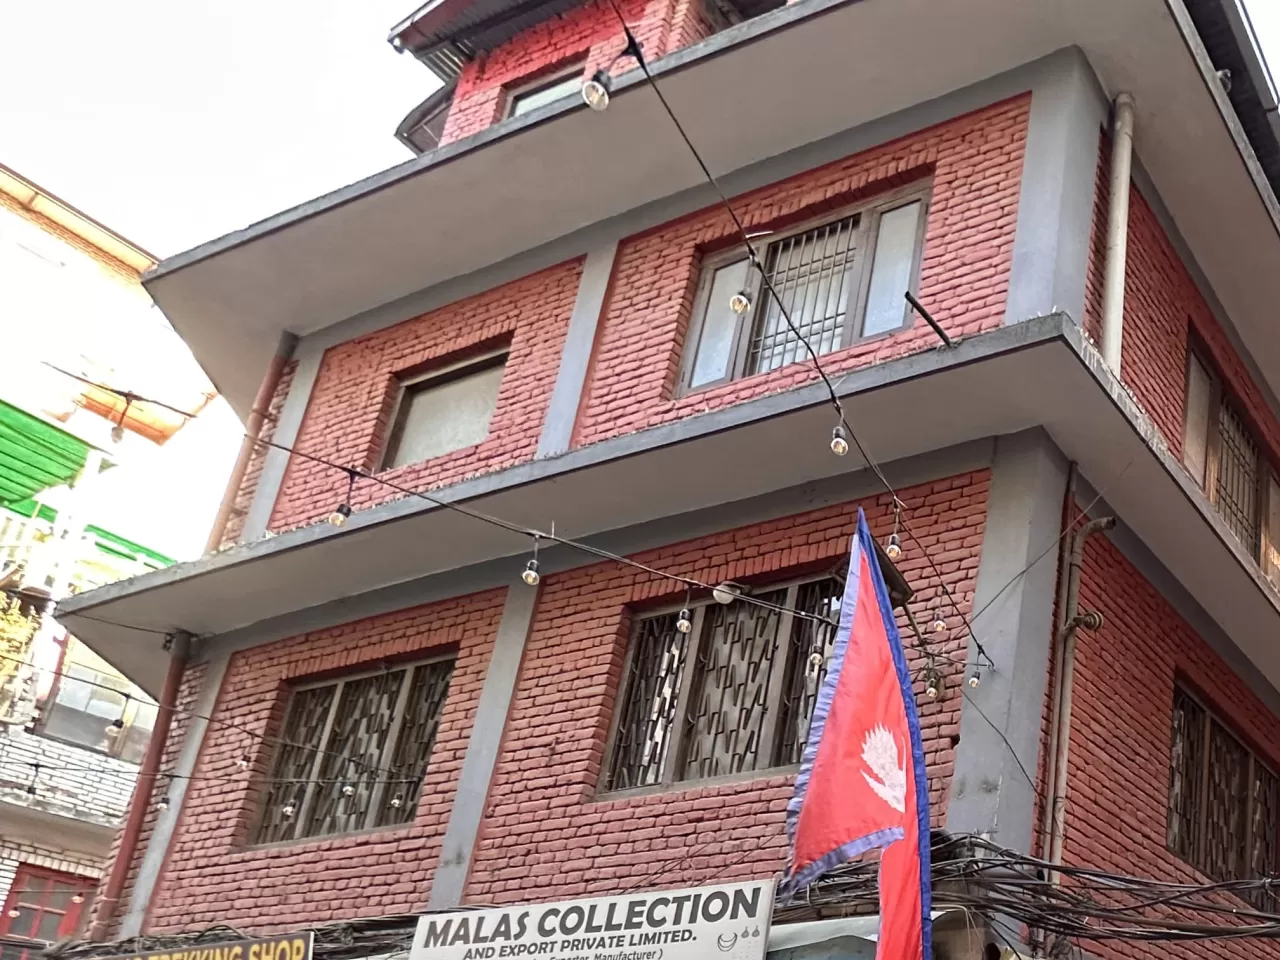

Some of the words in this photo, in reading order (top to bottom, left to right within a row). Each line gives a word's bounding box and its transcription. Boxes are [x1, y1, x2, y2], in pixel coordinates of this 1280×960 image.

[423, 911, 529, 948] MALAS
[537, 887, 762, 938] COLLECTION
[463, 947, 494, 960] AND
[499, 941, 557, 957] EXPORT
[560, 935, 625, 952] PRIVATE
[629, 929, 697, 946] LIMITED.
